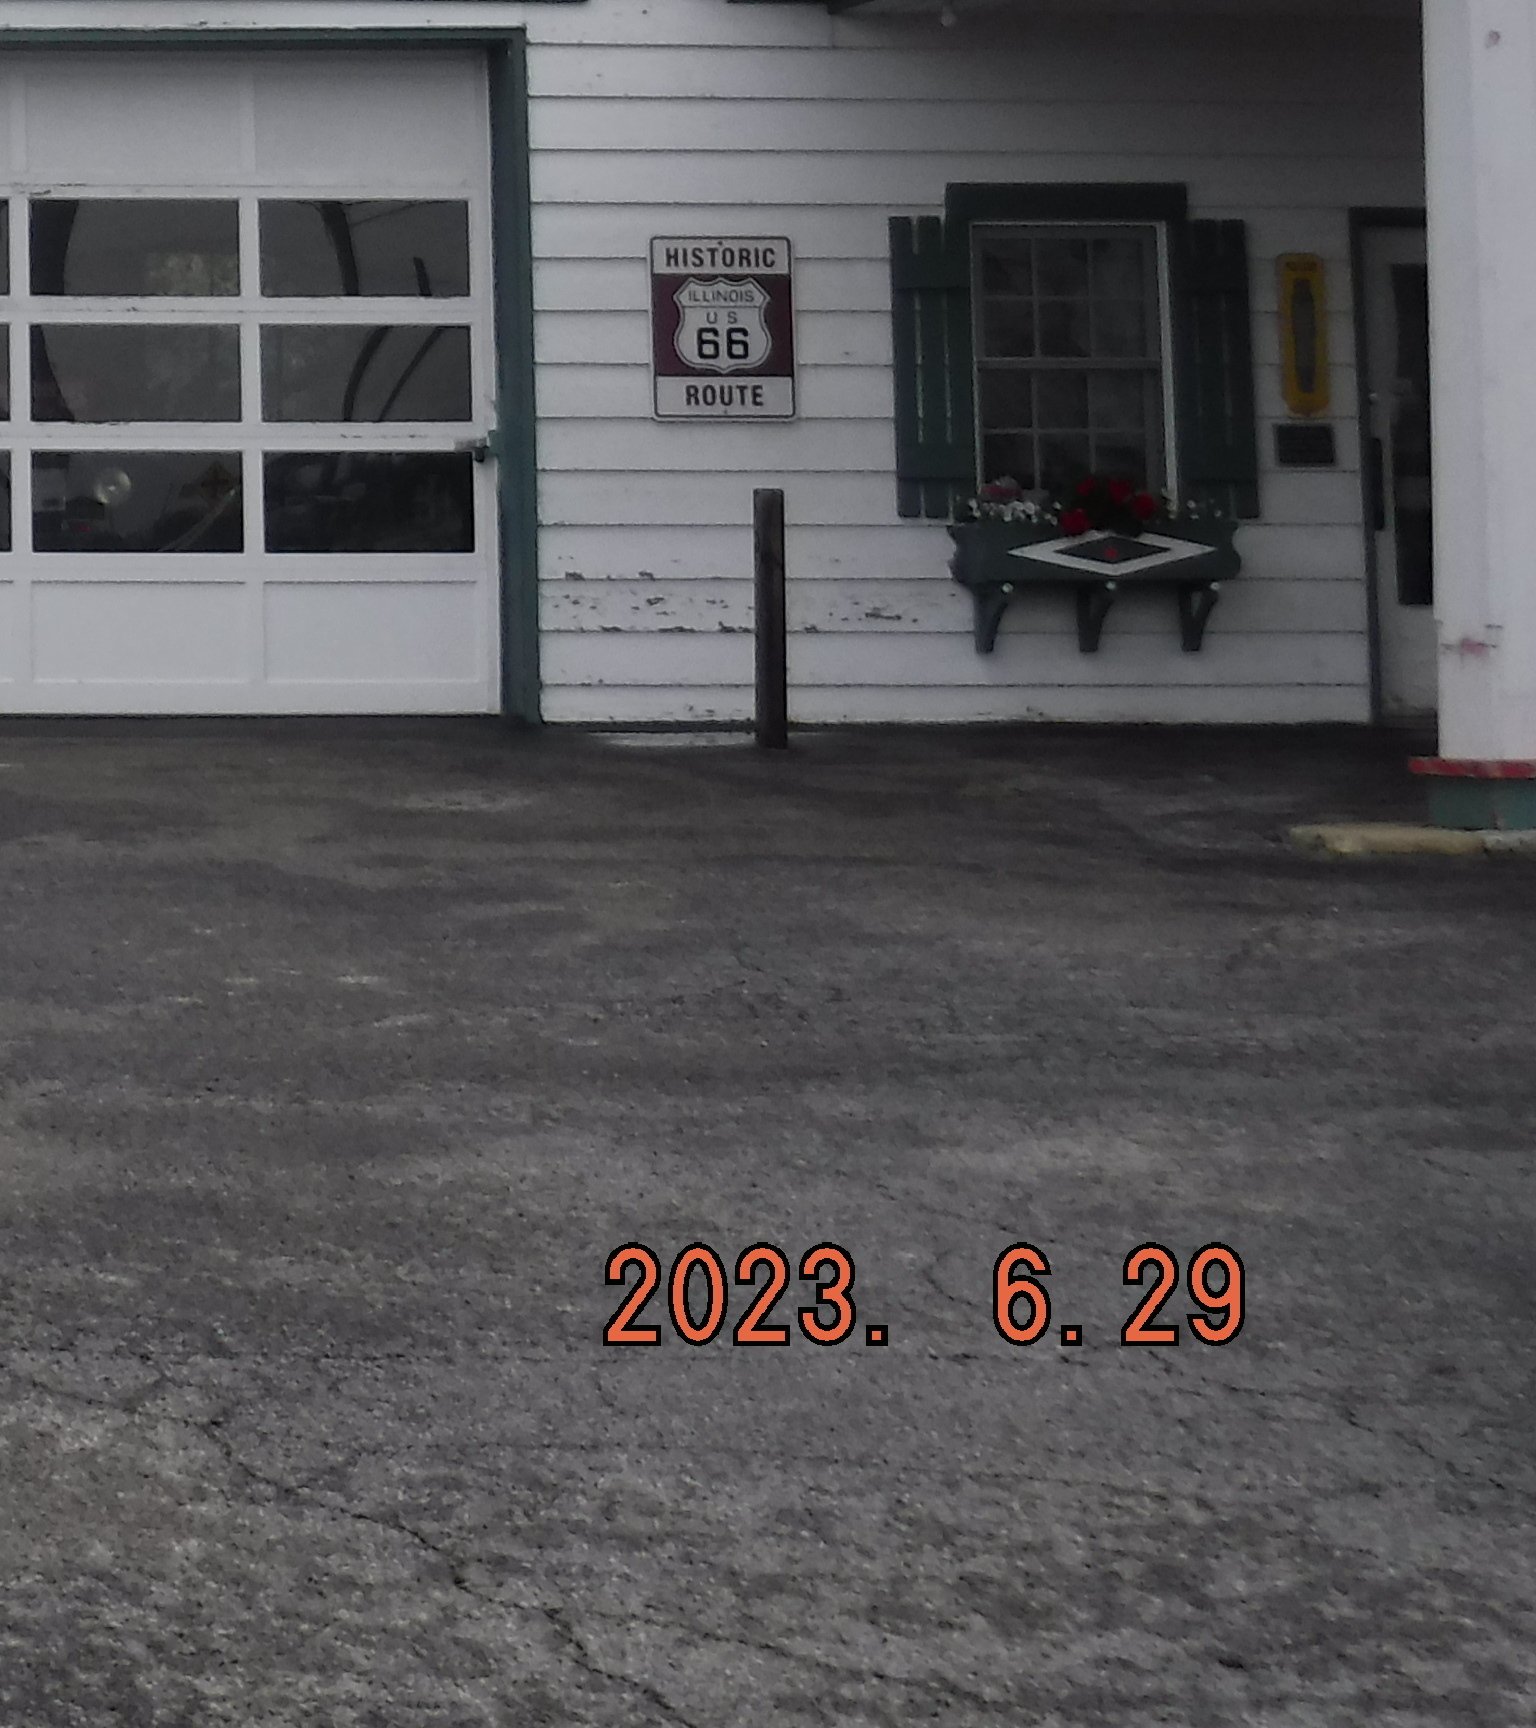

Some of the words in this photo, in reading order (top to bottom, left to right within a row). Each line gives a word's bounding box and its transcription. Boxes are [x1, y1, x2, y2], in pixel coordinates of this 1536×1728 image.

[665, 247, 776, 268] HISTORIC
[688, 289, 755, 303] ILLINOIS
[696, 327, 749, 360] 66
[685, 384, 764, 407] ROUTE
